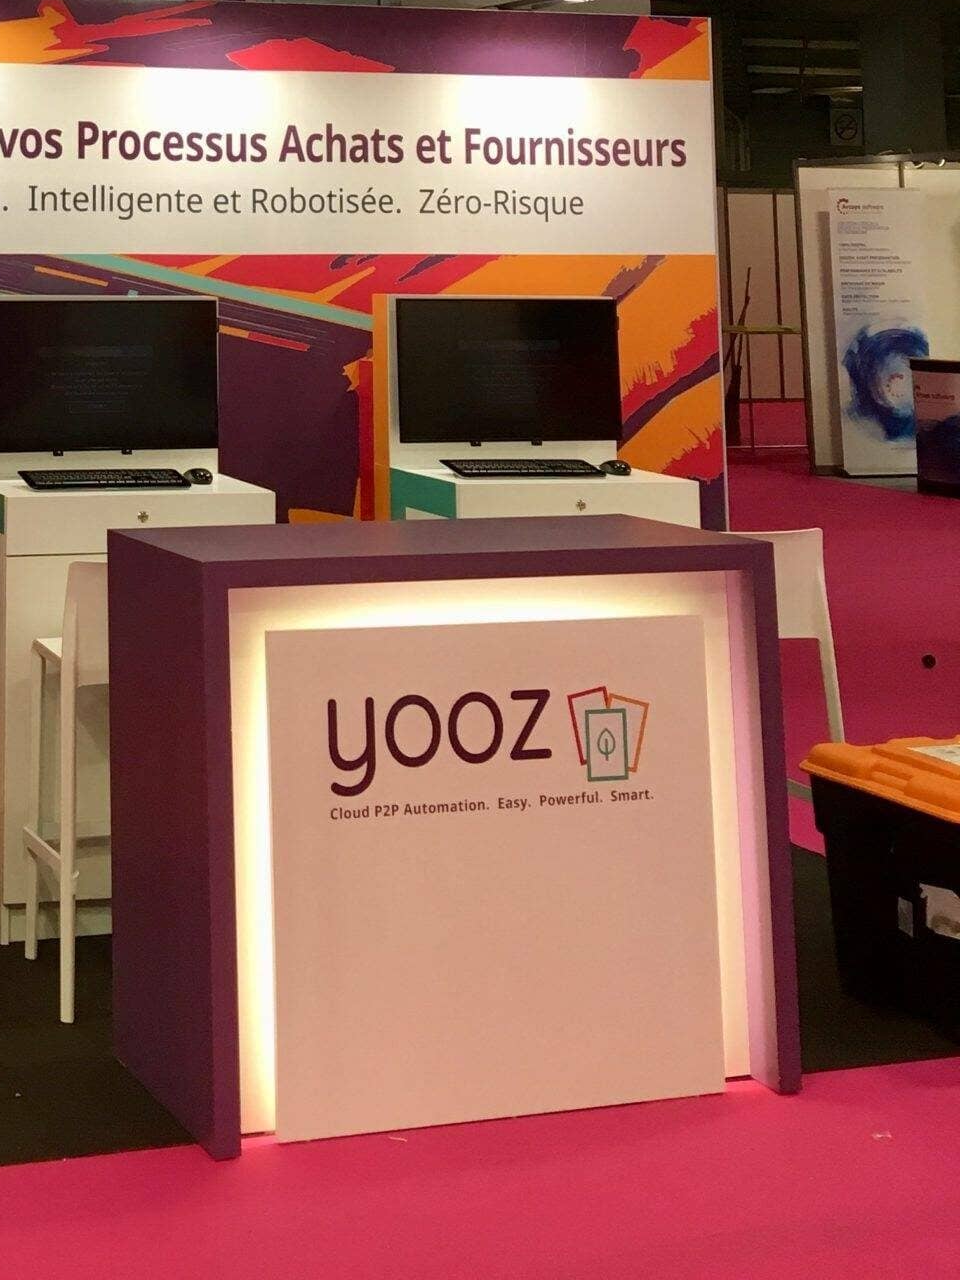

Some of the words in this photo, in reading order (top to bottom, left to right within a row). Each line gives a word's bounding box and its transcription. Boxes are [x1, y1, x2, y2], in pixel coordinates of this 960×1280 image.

[77, 121, 267, 163] Processus
[279, 123, 404, 164] Achats
[416, 130, 452, 164] et
[465, 128, 687, 167] Fournisseurs
[28, 185, 203, 220] Intelligente
[213, 192, 241, 214] et
[252, 187, 401, 215] Robotisée.
[419, 187, 584, 222] Zéro-Risque
[327, 689, 553, 797] yooz
[330, 806, 370, 820] Cloud
[375, 804, 399, 818] P2P
[404, 799, 490, 816] Automation.
[498, 796, 531, 812] Easy.
[539, 791, 603, 807] Powerful.
[610, 788, 655, 802] Smart.
